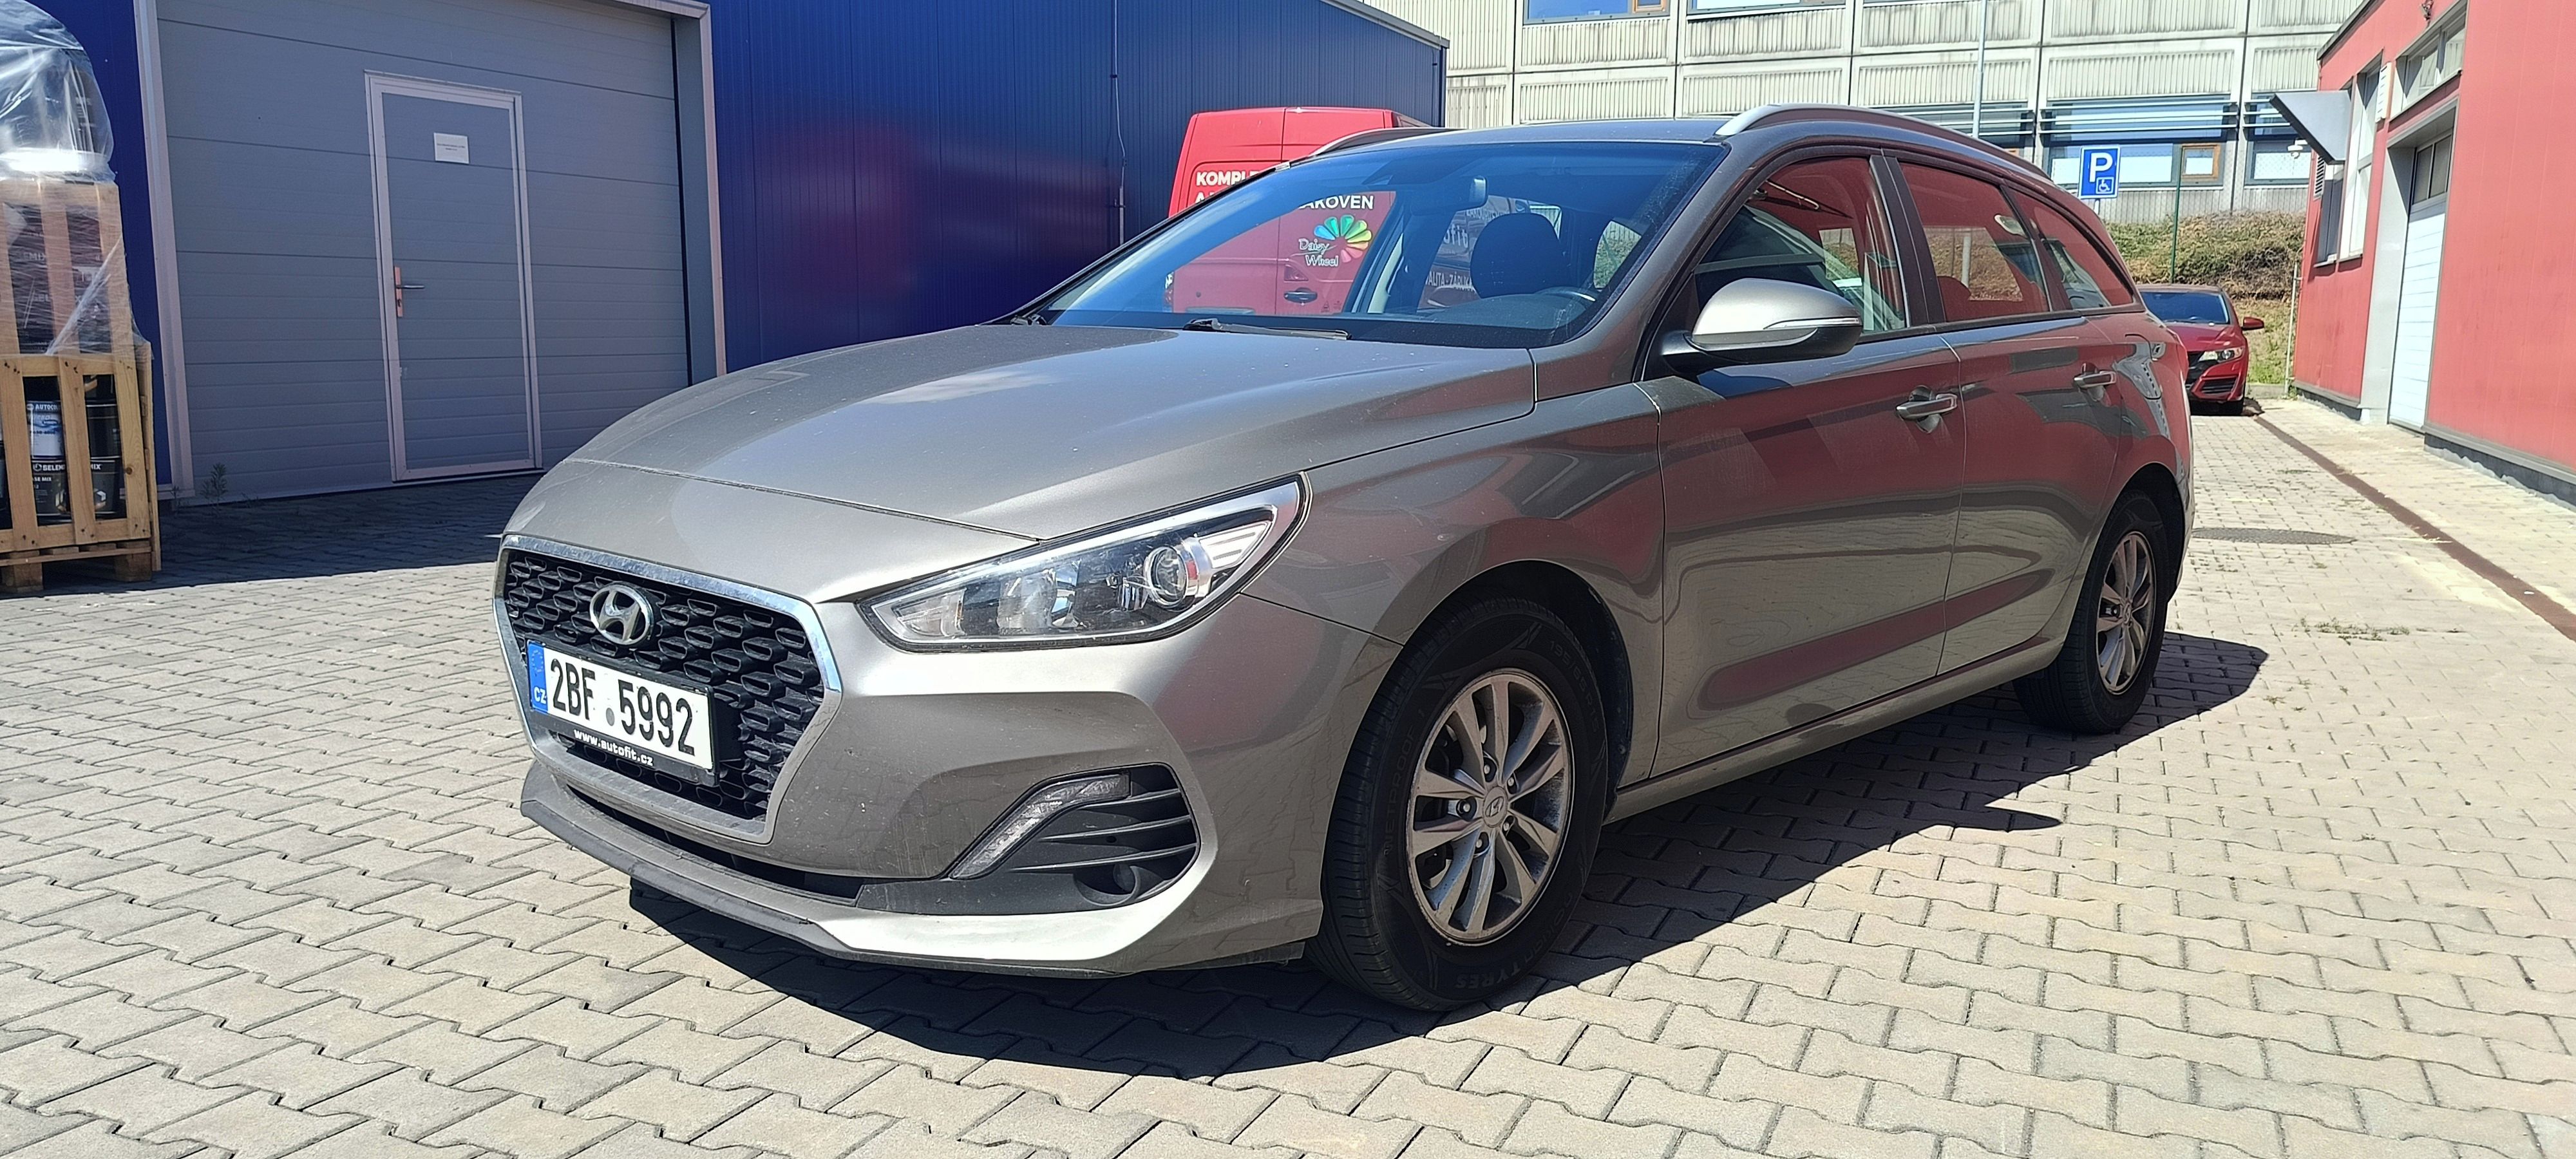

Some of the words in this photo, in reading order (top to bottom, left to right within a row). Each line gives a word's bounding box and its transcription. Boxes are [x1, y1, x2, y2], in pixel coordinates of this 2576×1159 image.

[2090, 153, 2113, 182] P
[1305, 254, 1339, 267] Wheel
[534, 686, 547, 704] CZ
[551, 658, 596, 721] 2BF
[618, 679, 696, 757] 5992
[574, 729, 654, 767] www.autofit.cz
[1454, 962, 1521, 989] TYRES
